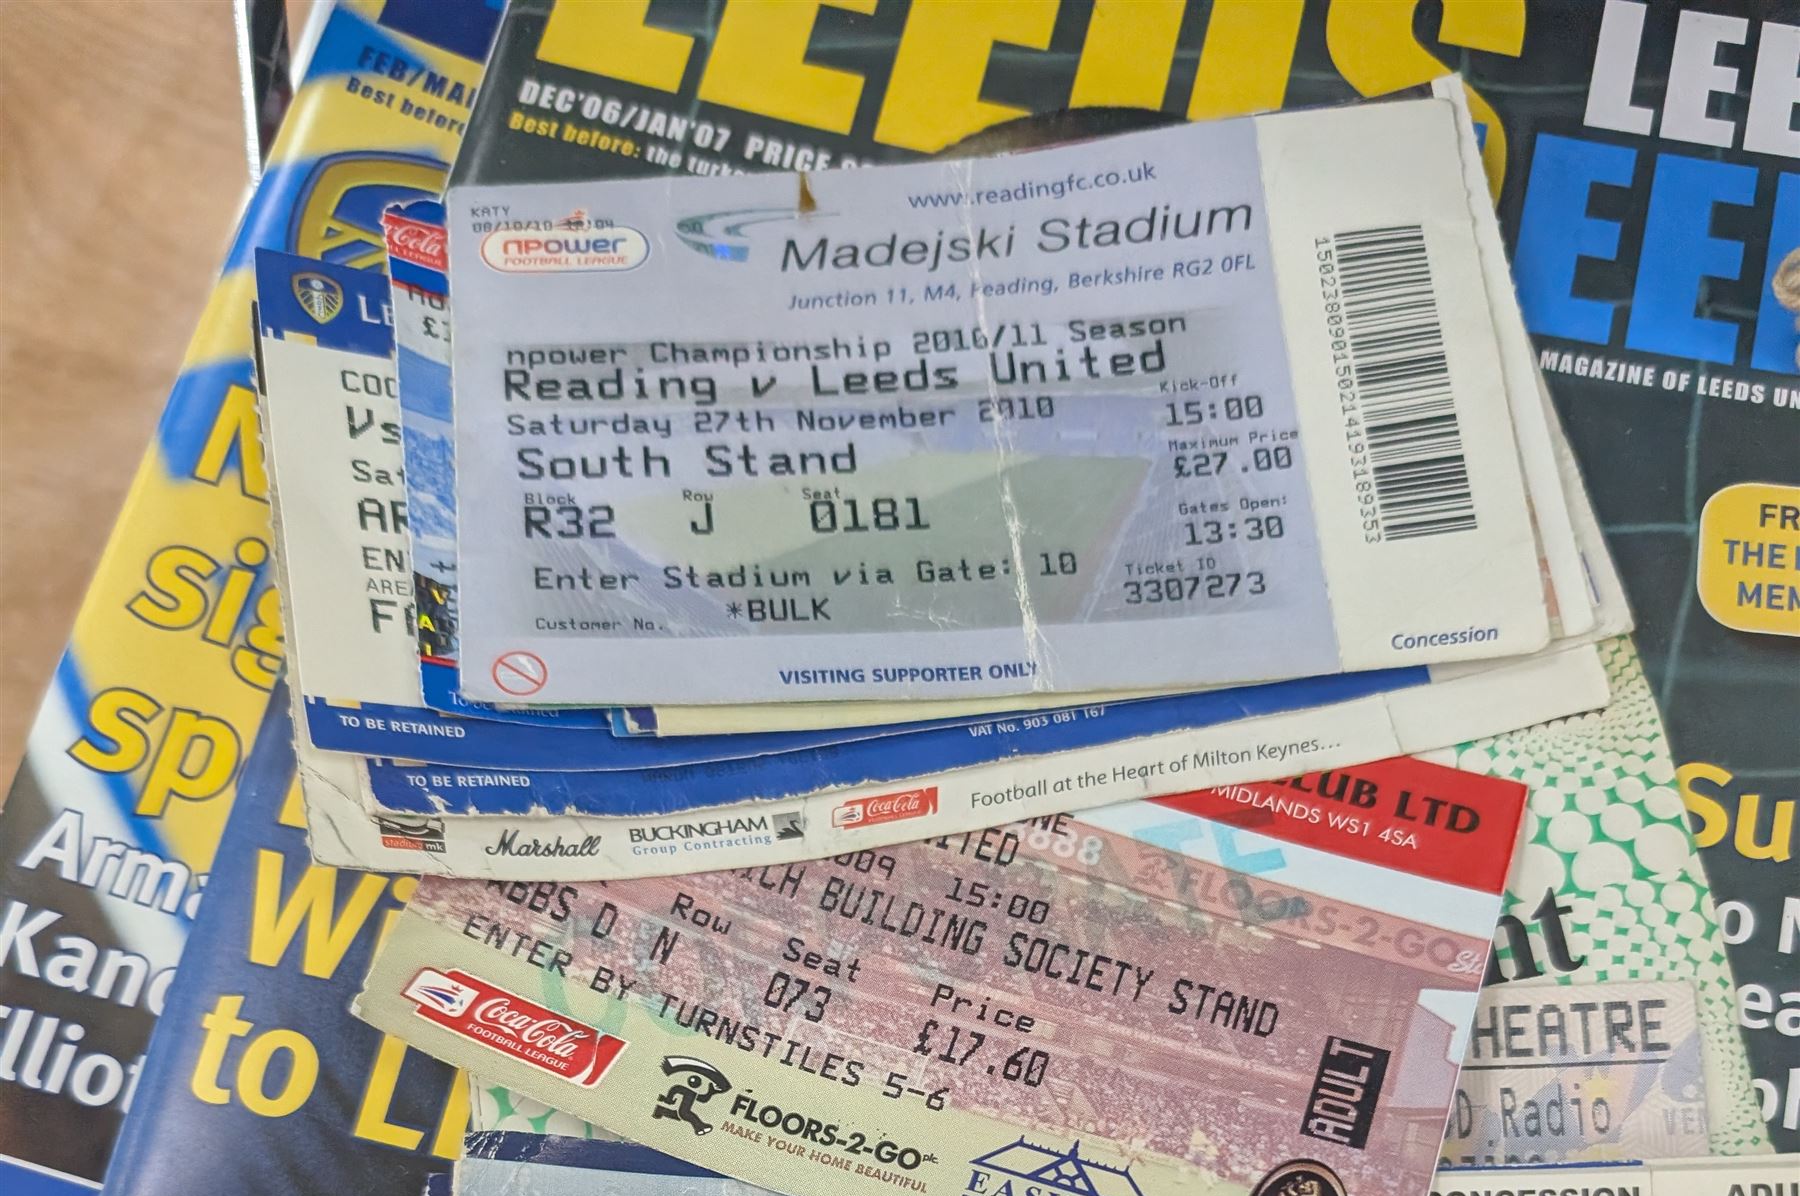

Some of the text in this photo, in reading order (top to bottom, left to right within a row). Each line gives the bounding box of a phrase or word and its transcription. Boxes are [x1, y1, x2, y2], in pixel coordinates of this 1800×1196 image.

[346, 76, 395, 108] Best
[509, 111, 683, 169] Best before: the
[908, 163, 1156, 209] www.readingfc.co.uk
[503, 238, 627, 255] npower
[781, 204, 1252, 273] Madejski Stadium
[504, 255, 629, 266] FOOTBALL LEAGUE
[789, 259, 1212, 311] Junction Berkshire RG2
[651, 314, 1187, 368] Championship Season
[503, 339, 1167, 406] Reading Leeds United
[1540, 350, 1765, 404] MAGAZINE OF LEEDS
[507, 401, 955, 439] Saturday 27th November
[1166, 396, 1265, 427] 15:00
[517, 442, 857, 480] South Stand
[523, 503, 616, 539] R32
[811, 497, 931, 533] 0181
[1185, 516, 1285, 547] 13:30
[534, 552, 1078, 591] Enter Stadium via Gate: 10
[1724, 539, 1786, 569] THE
[1123, 572, 1267, 605] 3307273
[1391, 625, 1498, 652] Concession
[780, 665, 983, 687] VISITING SUPPORTER
[391, 720, 466, 739] RETAINED
[458, 774, 530, 788] RETAINED
[972, 748, 1252, 810] Football the Heart Milton
[629, 815, 769, 844] BUCKINGHAM
[1394, 791, 1481, 834] LTD
[485, 829, 602, 858] Marshall
[632, 833, 772, 858] Group Contracting
[670, 892, 732, 936] Row
[783, 938, 862, 983] Seat
[820, 877, 1280, 1038] BUILDING SOCIETY STAND
[462, 914, 865, 1087] ENTER TURNSTILES
[764, 972, 832, 1024] 073
[930, 983, 1035, 1034] Price
[191, 995, 319, 1118] to
[467, 1023, 570, 1071] FOOTBALL LEAGUE
[913, 1019, 1050, 1087] £17.60
[1306, 1037, 1378, 1143] ADULT
[1501, 1084, 1611, 1137] Radio
[731, 1093, 922, 1171] FLOORS-2-GO
